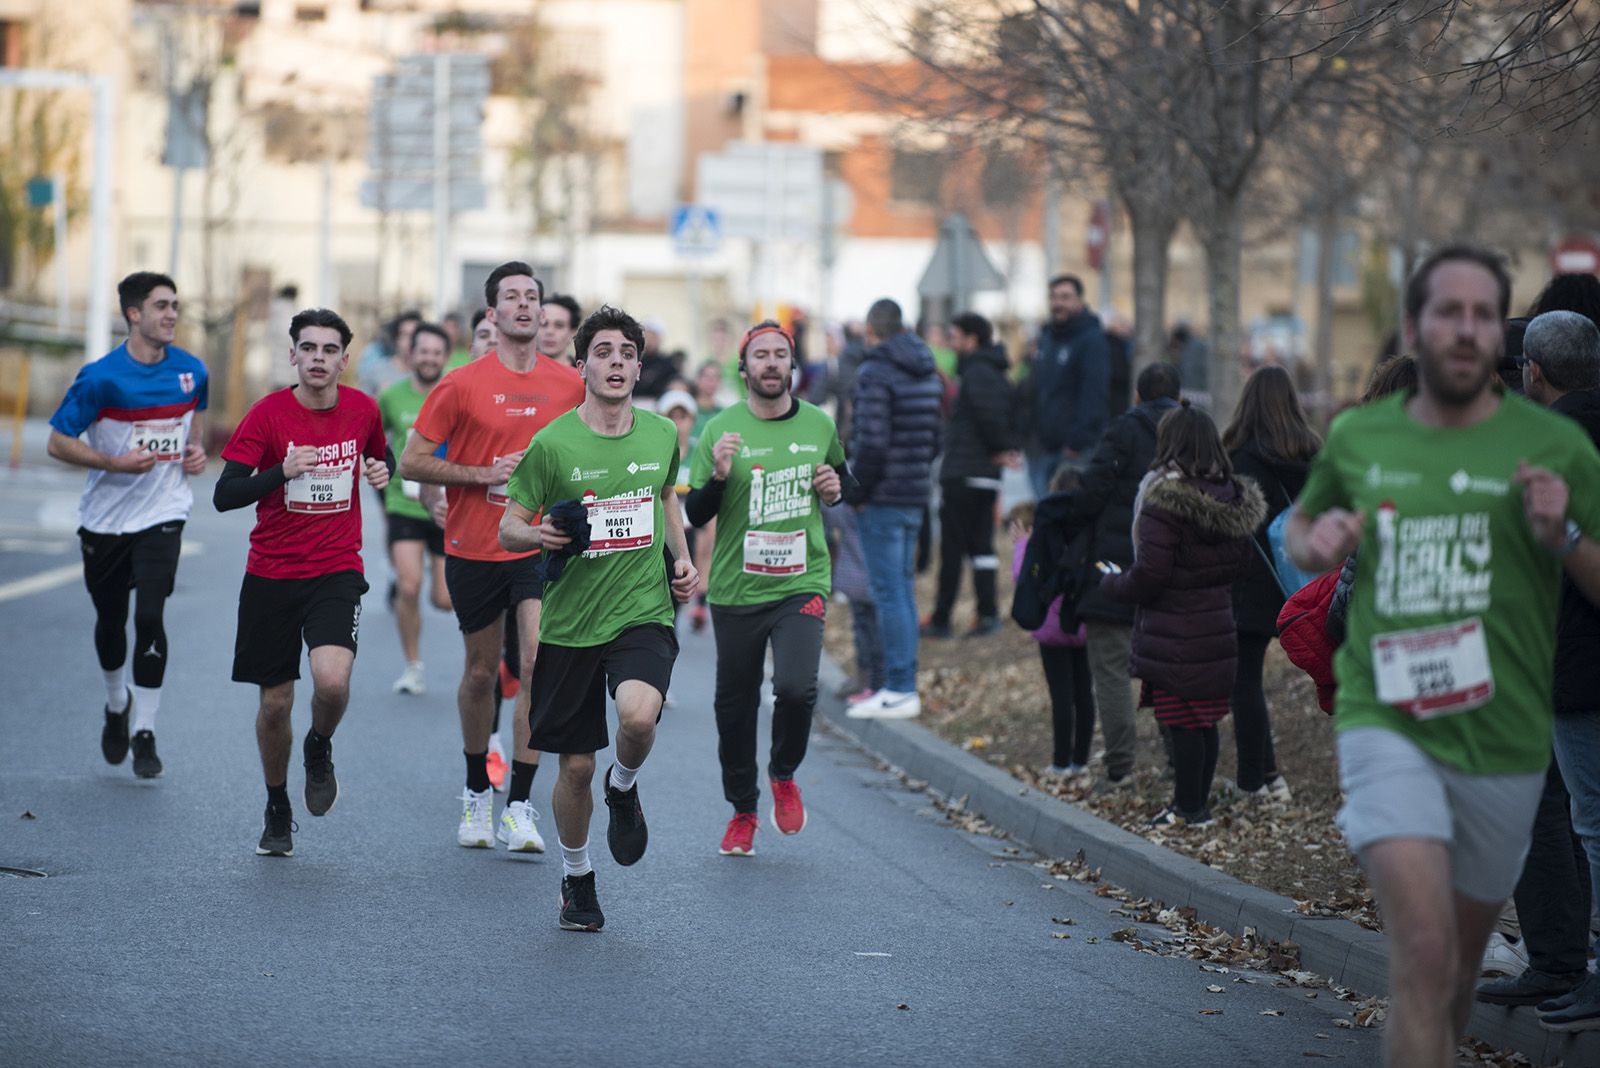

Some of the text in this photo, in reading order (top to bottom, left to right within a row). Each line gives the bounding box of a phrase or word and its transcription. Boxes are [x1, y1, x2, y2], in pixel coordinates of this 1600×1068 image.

[137, 438, 178, 452] 1021
[341, 439, 357, 458] DEL
[766, 463, 812, 486] CURSA DEL
[310, 484, 334, 492] ORIOL
[765, 480, 800, 504] GALL
[311, 492, 333, 501] 162
[605, 517, 633, 527] MARTI
[608, 527, 631, 538] 161
[765, 557, 786, 565] 677
